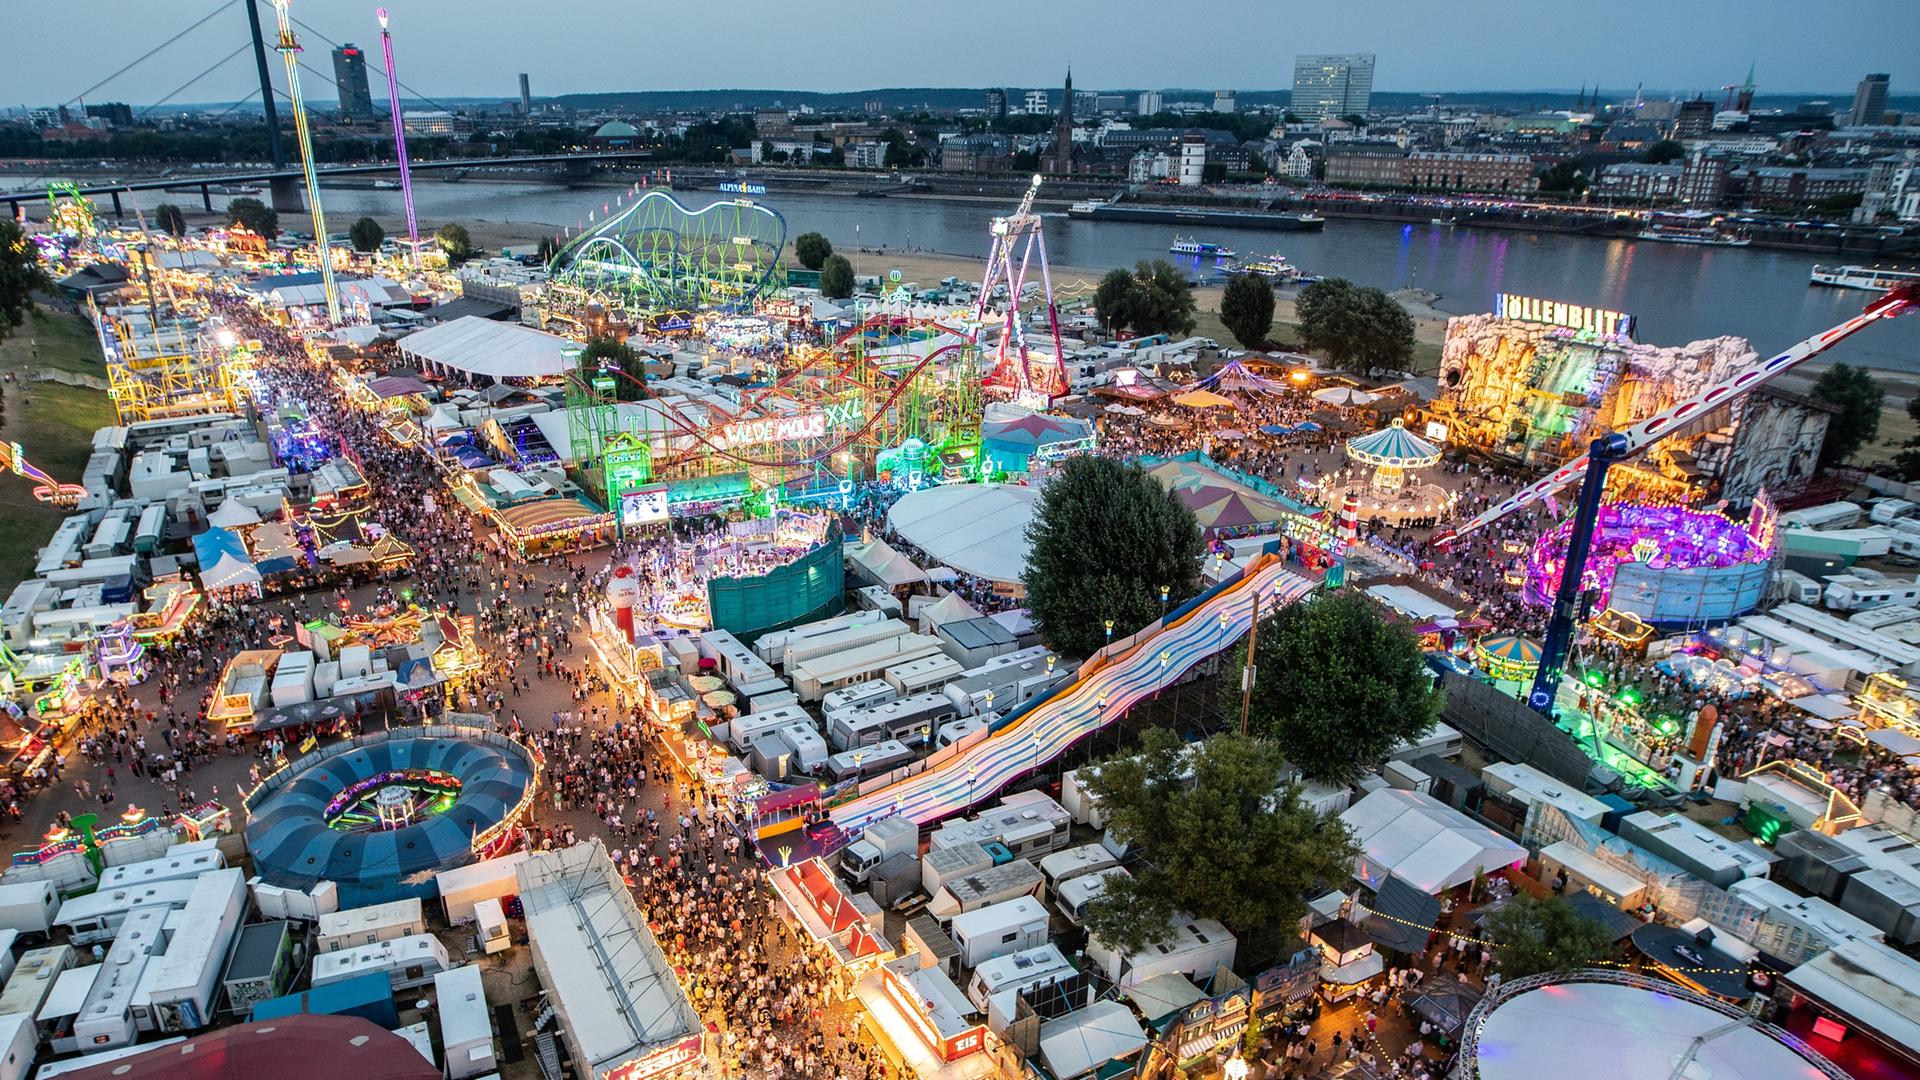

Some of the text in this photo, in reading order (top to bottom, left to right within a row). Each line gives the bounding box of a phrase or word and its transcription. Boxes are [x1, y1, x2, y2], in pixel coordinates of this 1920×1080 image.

[719, 182, 766, 194] ALPINA BAHN
[825, 399, 861, 426] XXL
[723, 414, 825, 445] WILDE MAUS
[955, 1035, 977, 1051] EIS
